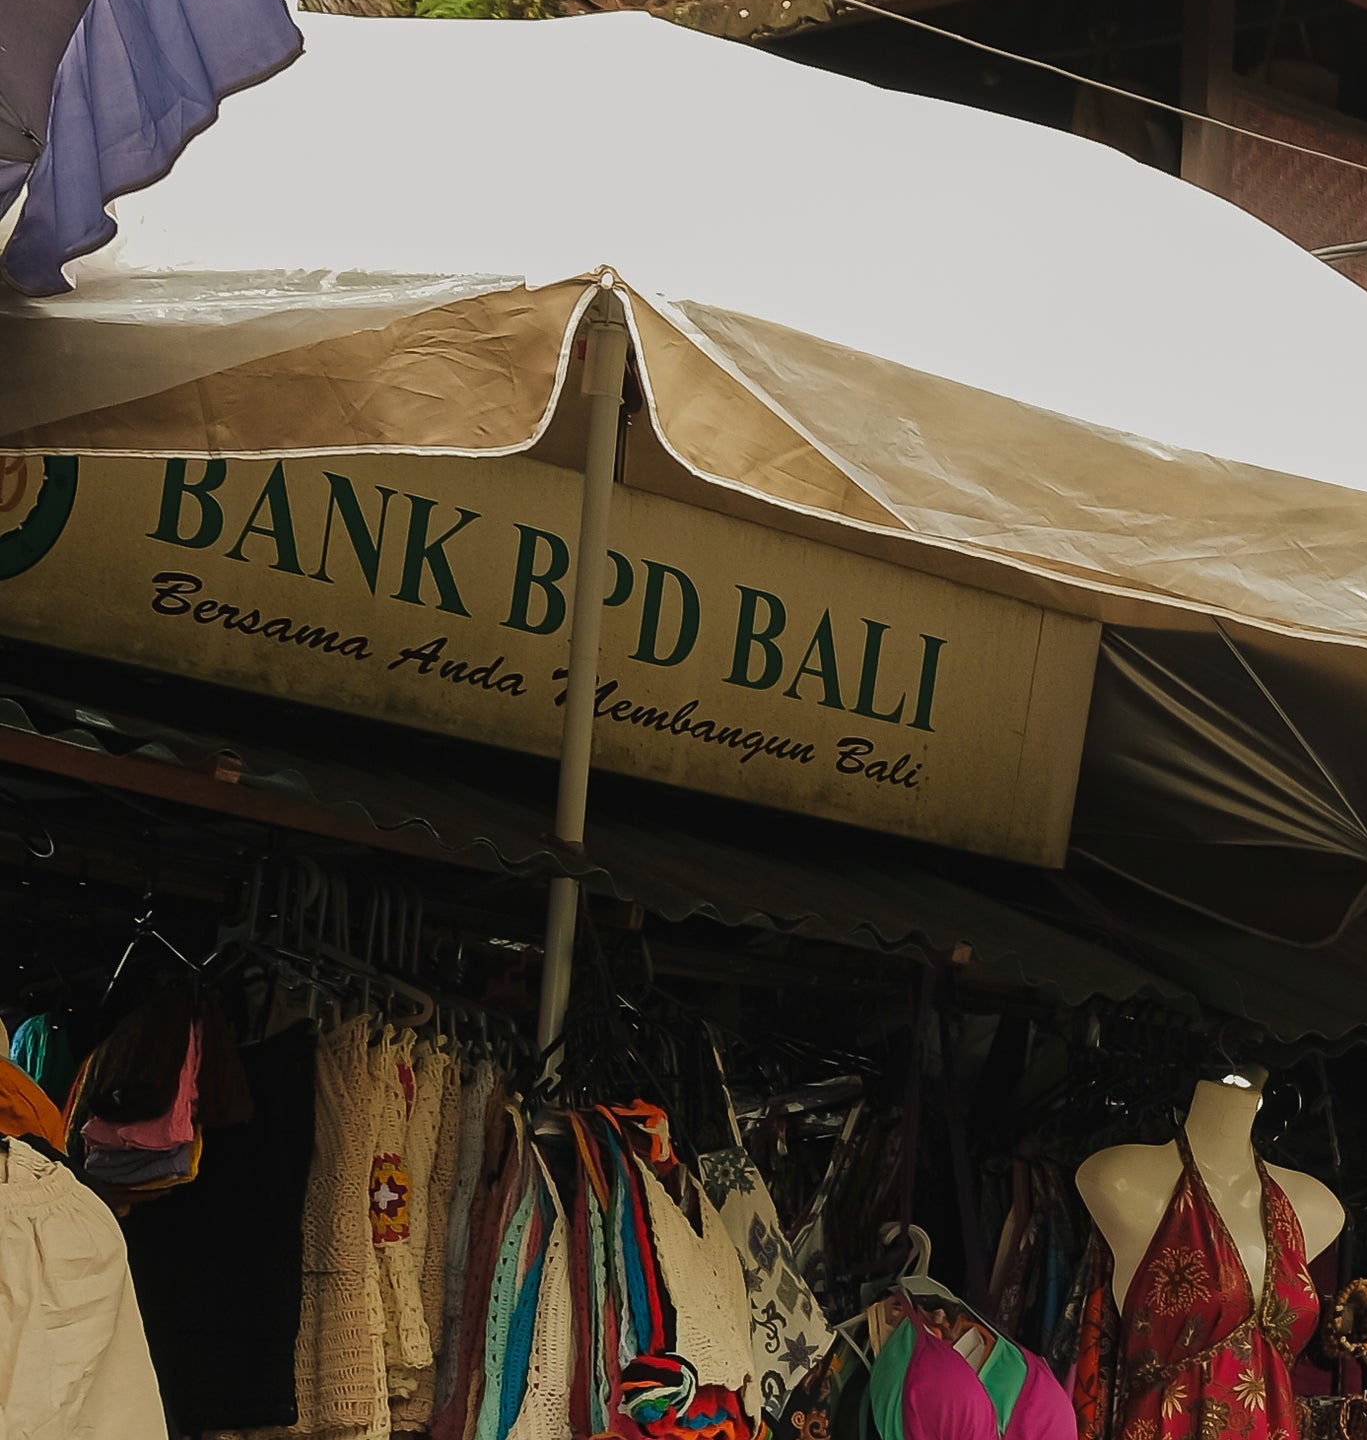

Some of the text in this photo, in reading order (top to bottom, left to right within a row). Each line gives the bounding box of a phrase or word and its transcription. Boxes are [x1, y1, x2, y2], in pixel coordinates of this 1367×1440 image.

[146, 457, 481, 619] BANK
[722, 583, 948, 734] BALI
[150, 570, 373, 662] Bersama
[387, 635, 527, 697] Anda
[835, 735, 923, 790] Bali
